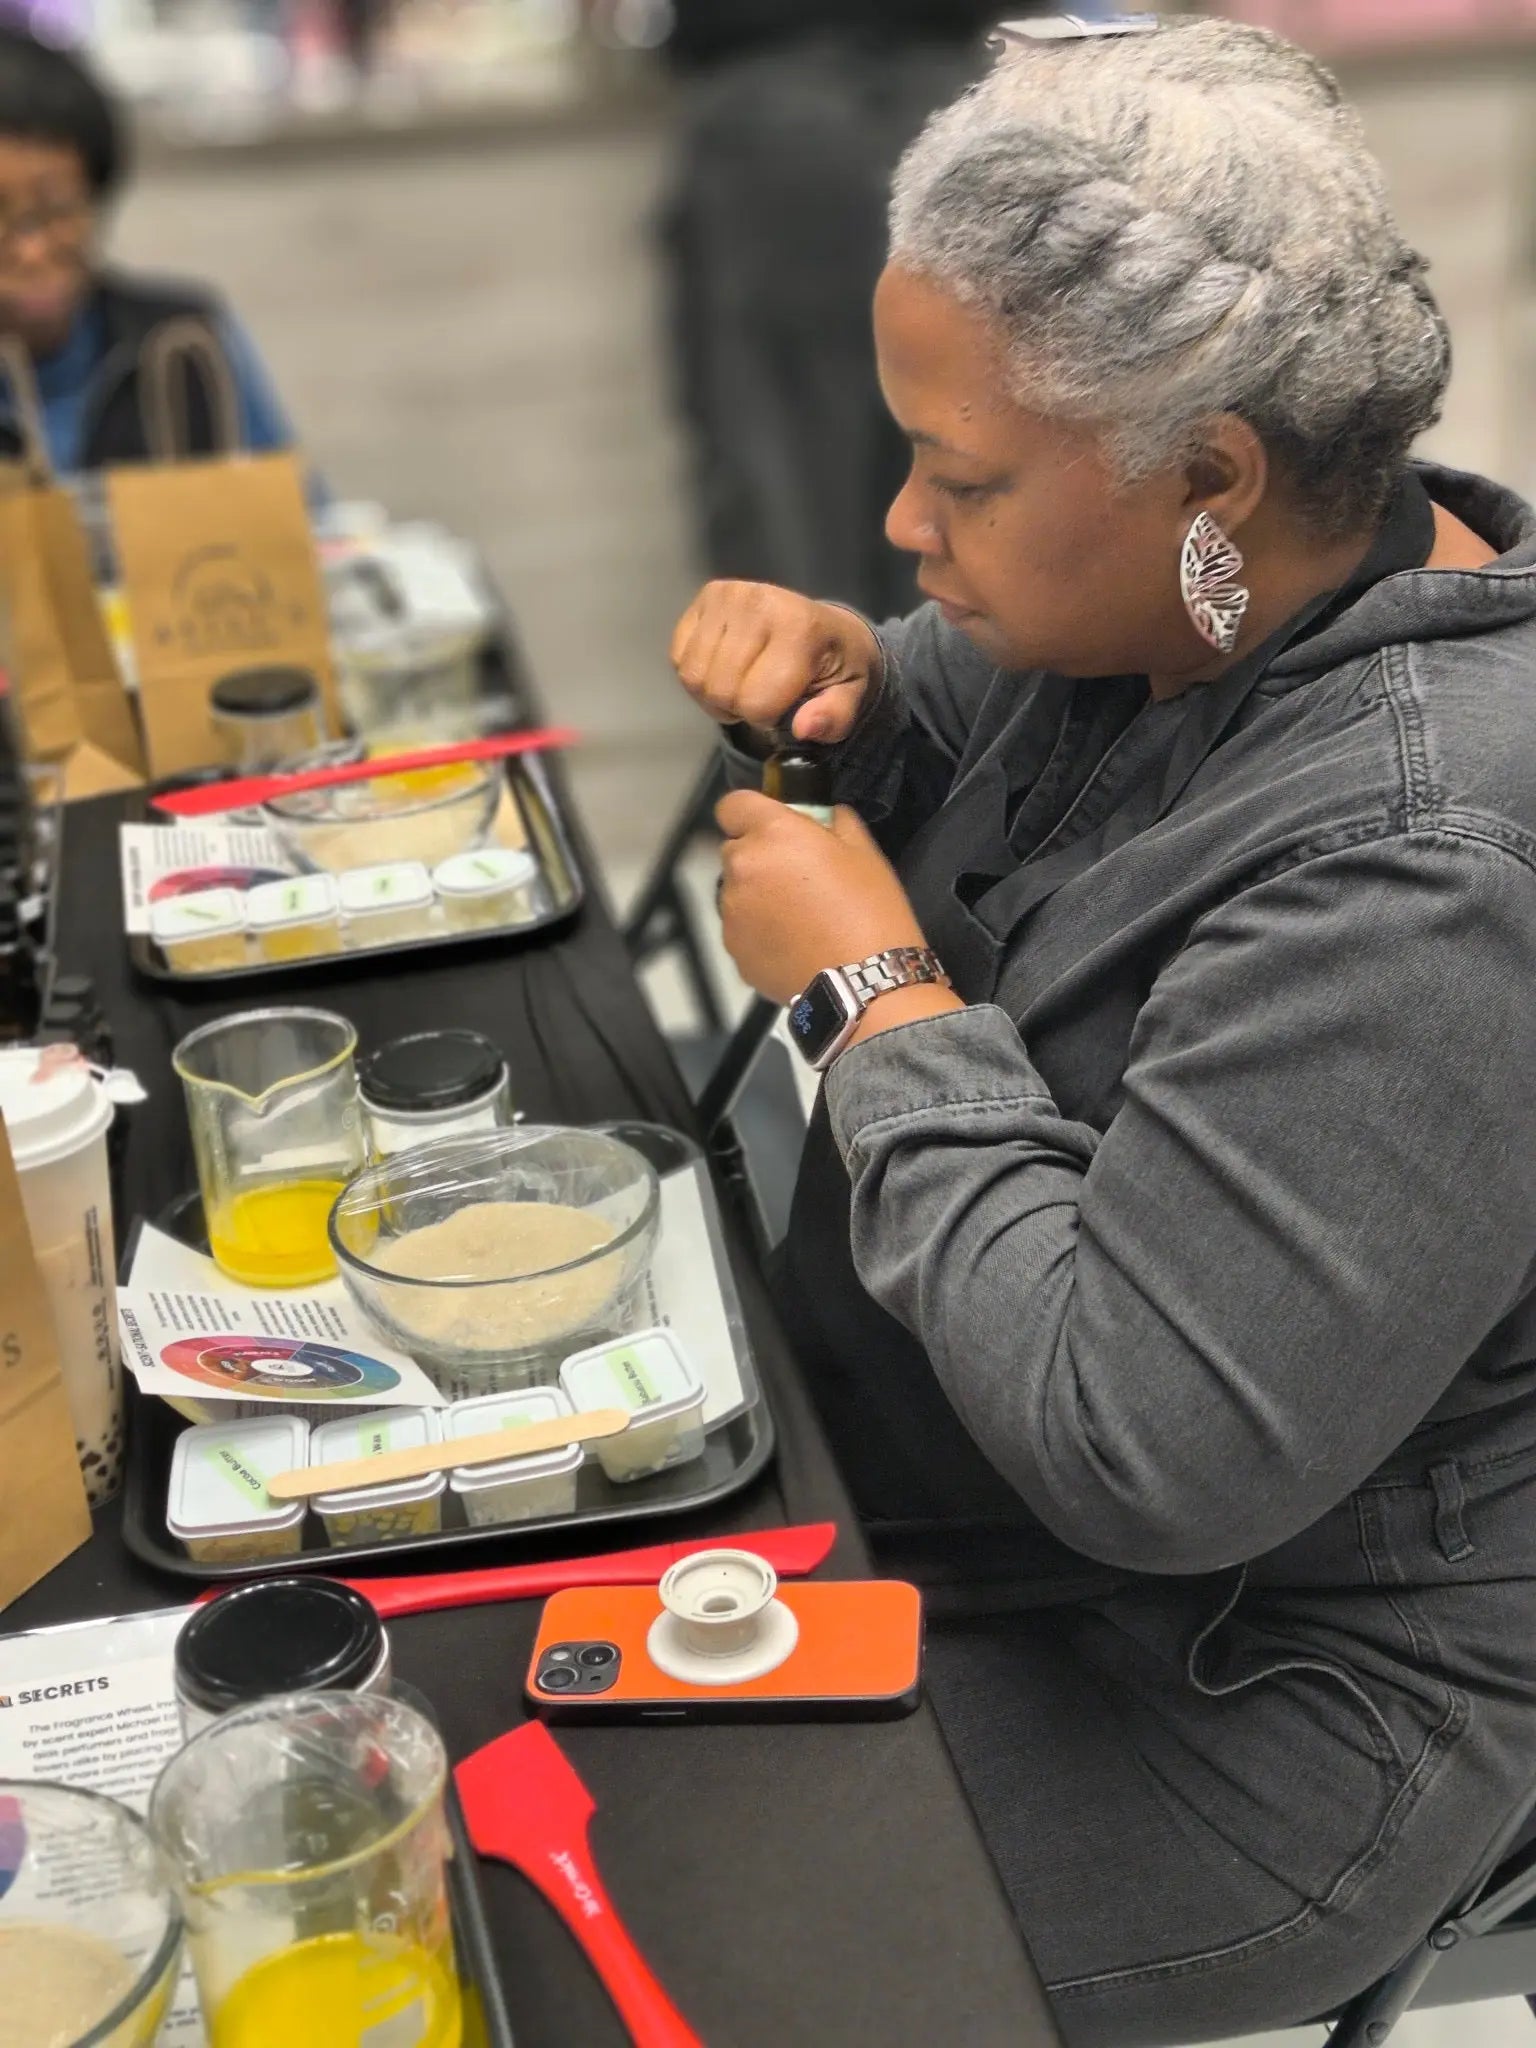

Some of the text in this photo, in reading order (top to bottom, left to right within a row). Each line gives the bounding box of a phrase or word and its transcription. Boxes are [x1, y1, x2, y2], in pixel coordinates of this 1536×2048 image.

[219, 1450, 261, 1490] Cocoa Butter
[18, 1677, 110, 1705] SECRETS
[23, 1739, 38, 1749] by
[42, 1733, 74, 1745] scent
[77, 1724, 113, 1739] expert
[116, 1716, 161, 1731] Michael
[30, 1724, 51, 1733] The
[53, 1712, 113, 1730] Fragrance
[33, 1761, 69, 1773] lovers
[72, 1756, 100, 1768] alike
[102, 1751, 117, 1762] by
[119, 1743, 163, 1760] placing
[62, 1738, 122, 1757] perfumers
[125, 1731, 149, 1743] and
